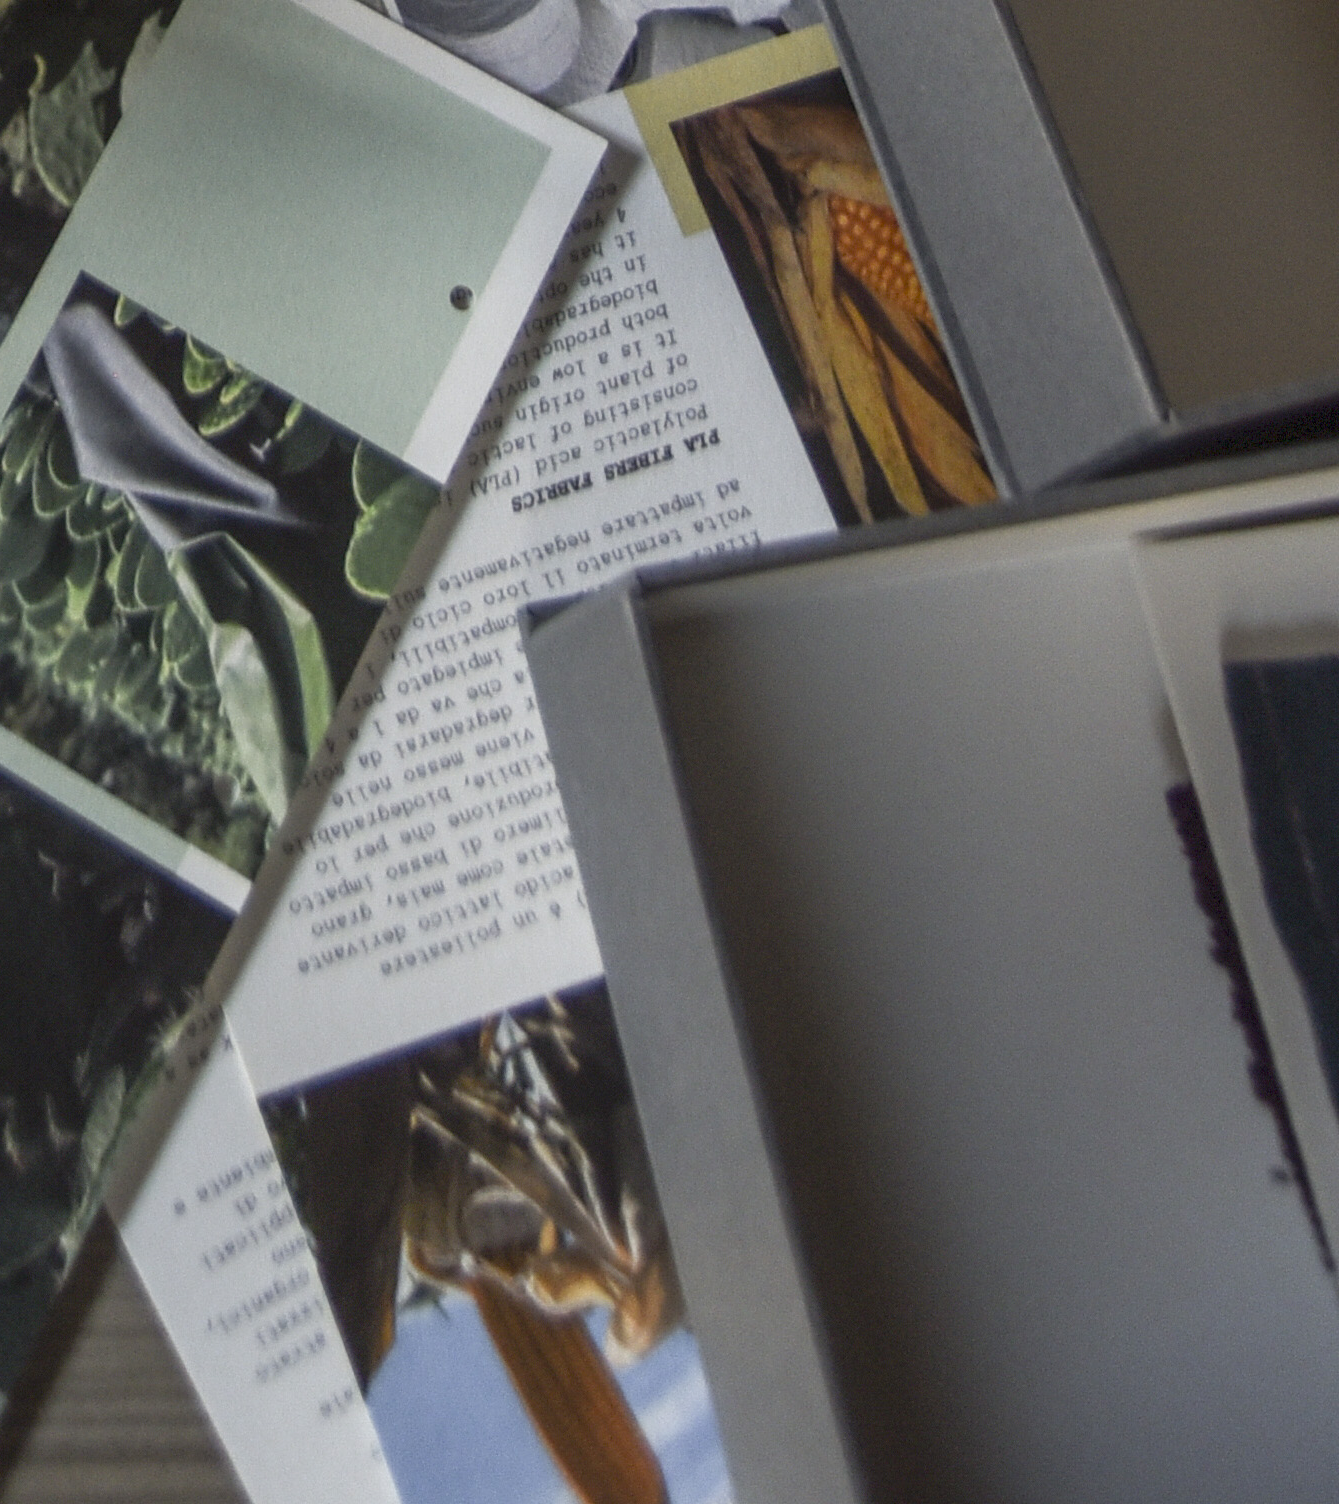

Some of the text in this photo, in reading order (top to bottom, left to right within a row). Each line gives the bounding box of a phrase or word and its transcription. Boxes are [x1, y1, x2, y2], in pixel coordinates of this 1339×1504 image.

[469, 402, 709, 499] Polylactic acid (PLA)
[511, 428, 721, 513] PLA FIBERS FABRICS
[381, 505, 753, 643] volta terminato il loro ciclo di
[324, 727, 535, 809] viene messo nelle
[297, 865, 574, 975] acido lattico derivante
